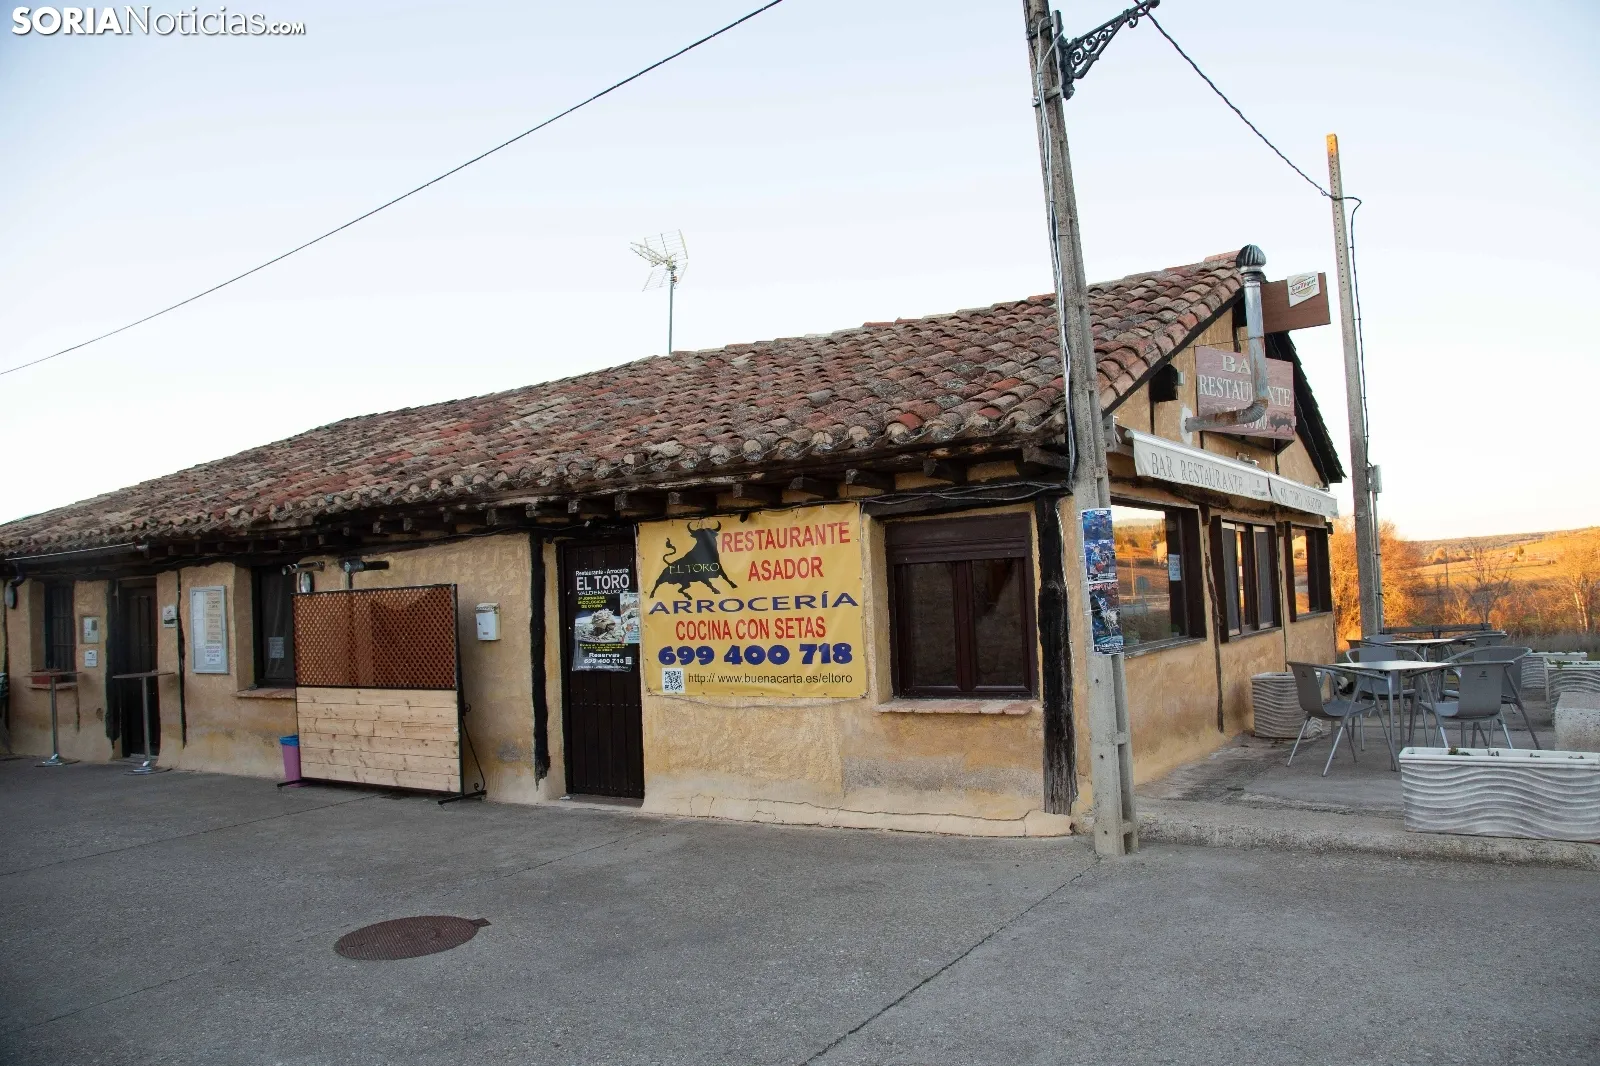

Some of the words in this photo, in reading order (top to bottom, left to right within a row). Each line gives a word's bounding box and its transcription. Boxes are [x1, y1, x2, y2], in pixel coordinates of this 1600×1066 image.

[1197, 374, 1292, 407] RESTAUNTE
[1151, 452, 1176, 479] BAR
[1180, 459, 1244, 495] RESTAURANTE
[721, 521, 851, 553] RESTAURANTE
[669, 564, 685, 575] EL
[685, 562, 720, 574] TORO
[748, 556, 824, 582] ASADOR
[577, 577, 591, 590] EL
[594, 574, 629, 589] TORO
[648, 591, 859, 615] ARROCERÍA
[675, 619, 733, 641] COCINA
[735, 618, 770, 640] CON
[774, 616, 826, 639] SETAS
[658, 645, 715, 665] 699
[723, 644, 790, 665] 400
[799, 642, 853, 664] 718
[717, 672, 853, 684] www.buenacarta.es/eltoro
